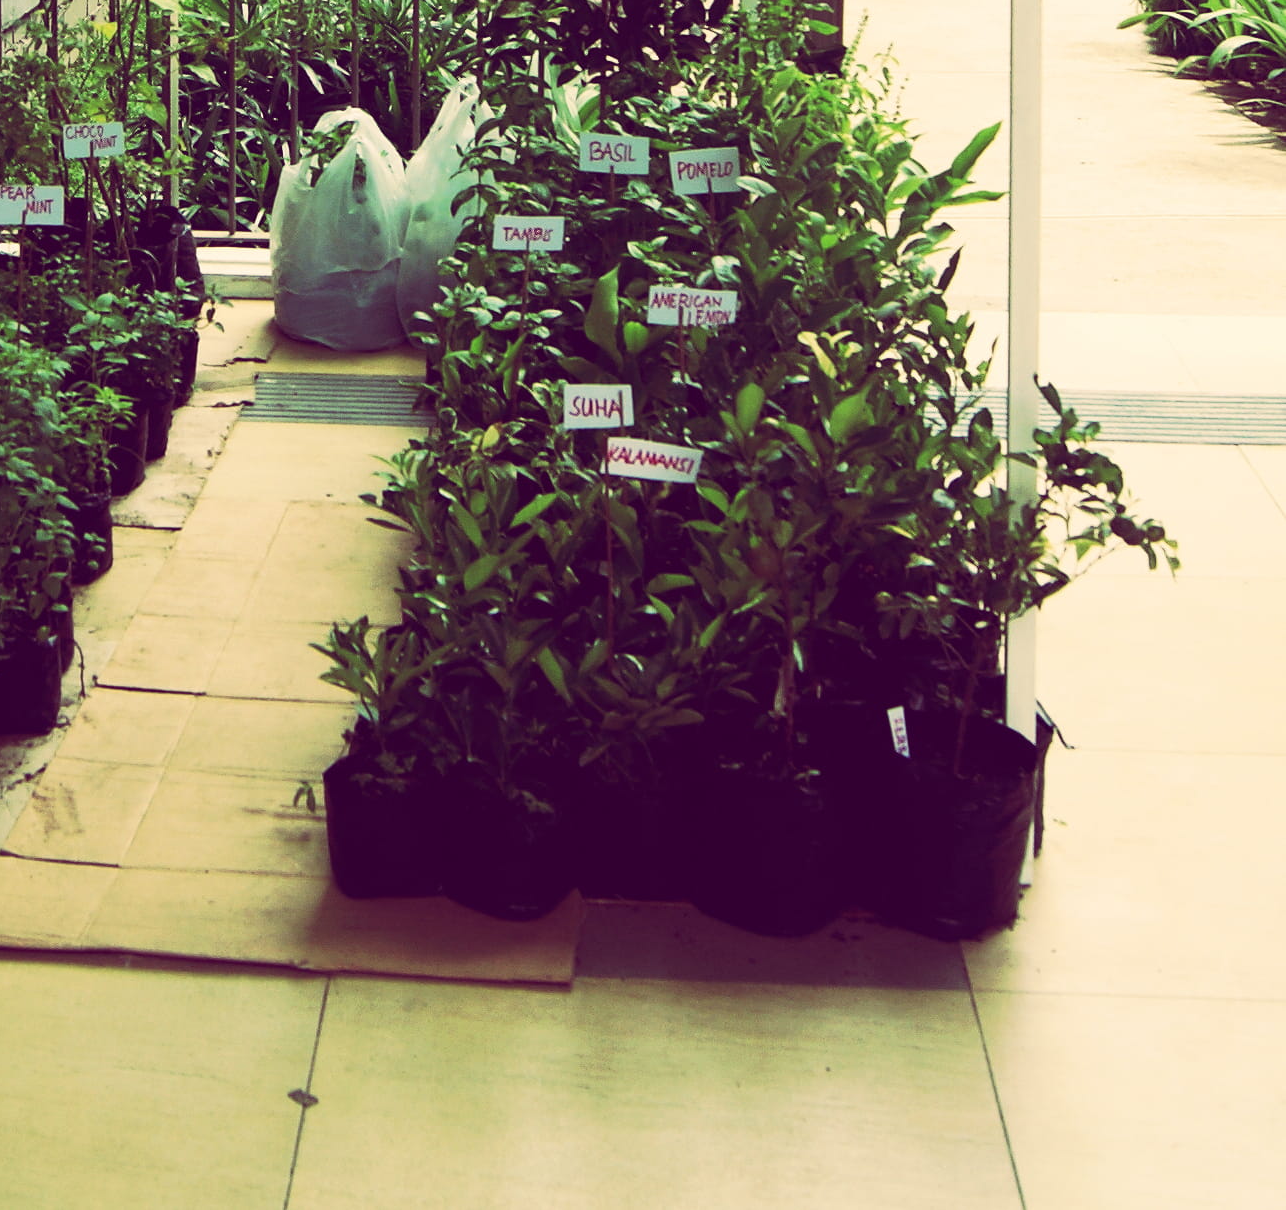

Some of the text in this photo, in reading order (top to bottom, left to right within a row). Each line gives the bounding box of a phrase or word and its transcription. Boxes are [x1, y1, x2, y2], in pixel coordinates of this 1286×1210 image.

[65, 125, 104, 140] CHOCO
[92, 135, 118, 150] MINT
[588, 141, 637, 163] BASIL
[676, 161, 734, 181] POMELO
[26, 199, 54, 215] MINT
[650, 292, 723, 309] AMERICAN
[569, 395, 622, 419] SUHA
[607, 444, 696, 475] KALAMANSI
